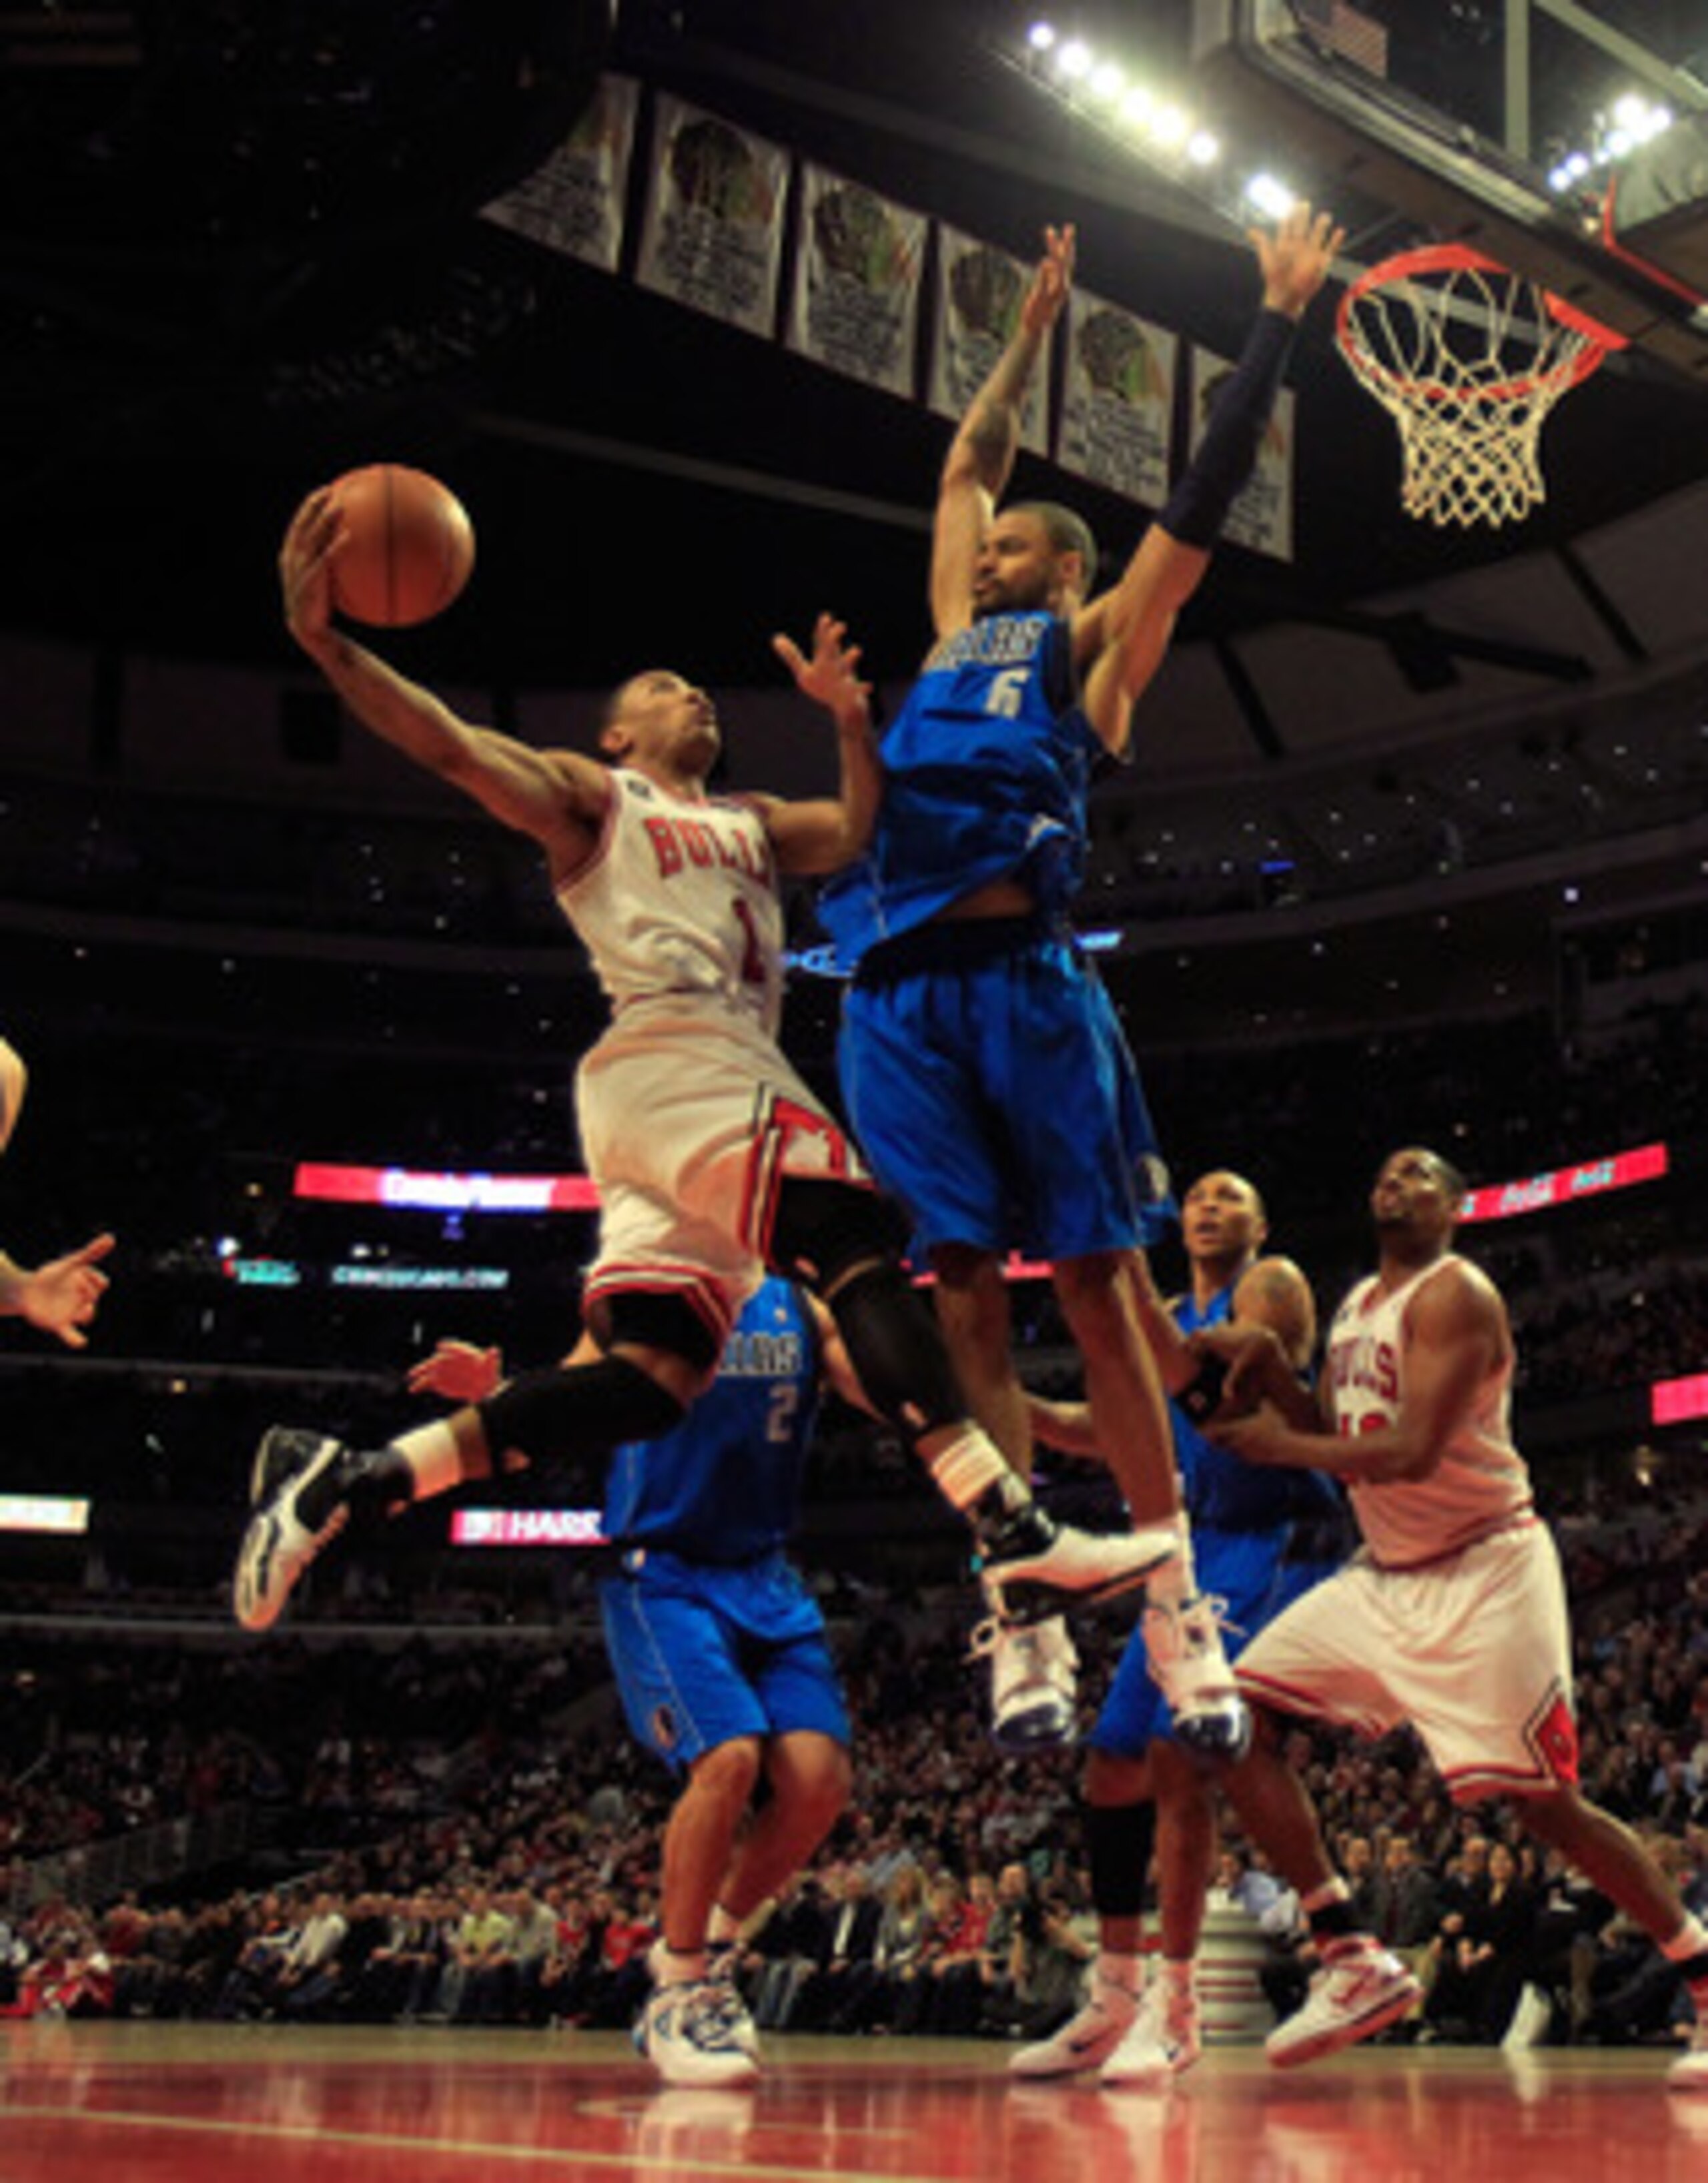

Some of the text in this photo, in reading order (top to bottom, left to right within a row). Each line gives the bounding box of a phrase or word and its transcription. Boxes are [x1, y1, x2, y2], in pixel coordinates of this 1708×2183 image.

[985, 667, 1031, 721] 6
[643, 811, 771, 890] BULL
[733, 897, 766, 983] 1
[767, 1383, 799, 1442] 2
